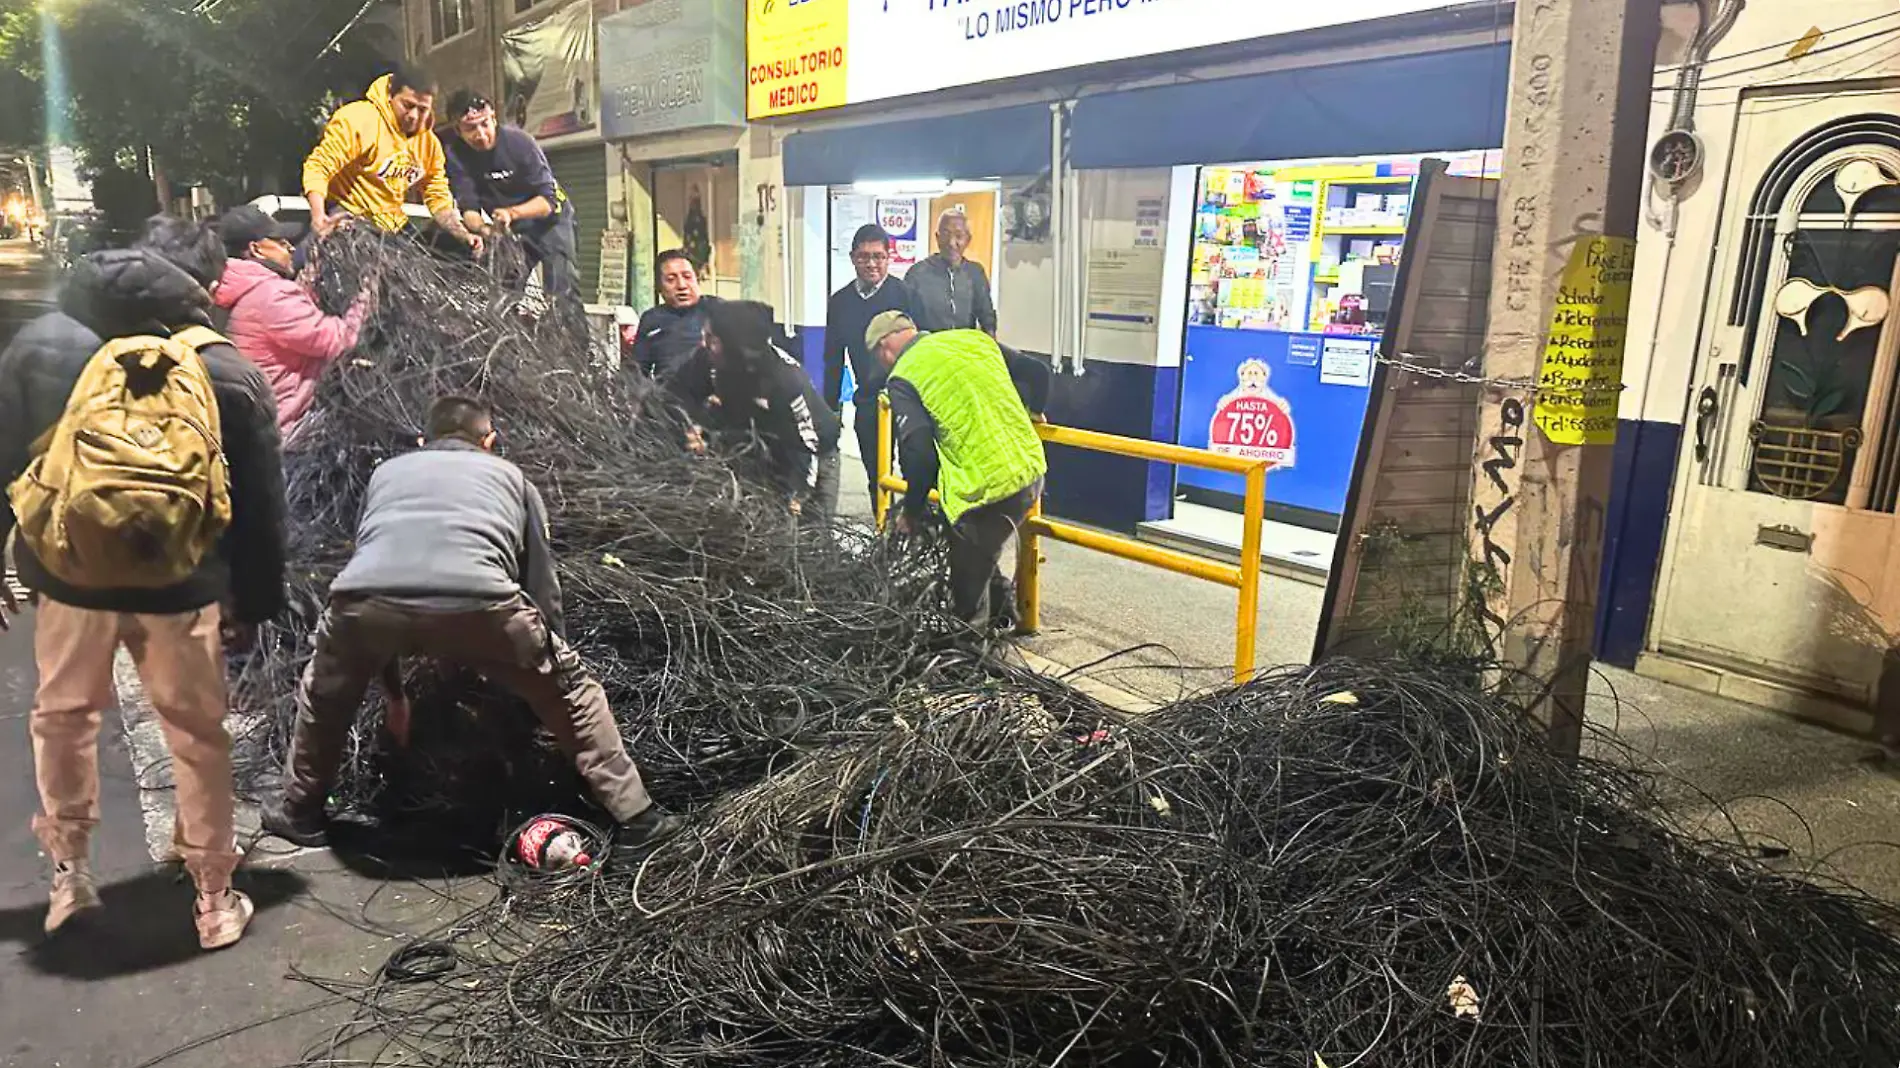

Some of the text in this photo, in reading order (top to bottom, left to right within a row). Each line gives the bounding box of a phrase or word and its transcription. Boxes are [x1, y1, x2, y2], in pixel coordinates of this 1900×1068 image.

[995, 0, 1062, 34] MISMO
[750, 46, 843, 85] CONSULTORIO
[769, 81, 819, 110] MEDICO
[1236, 402, 1268, 412] HASTA
[1227, 411, 1278, 446] 75%
[1239, 449, 1285, 460] AHORRO
